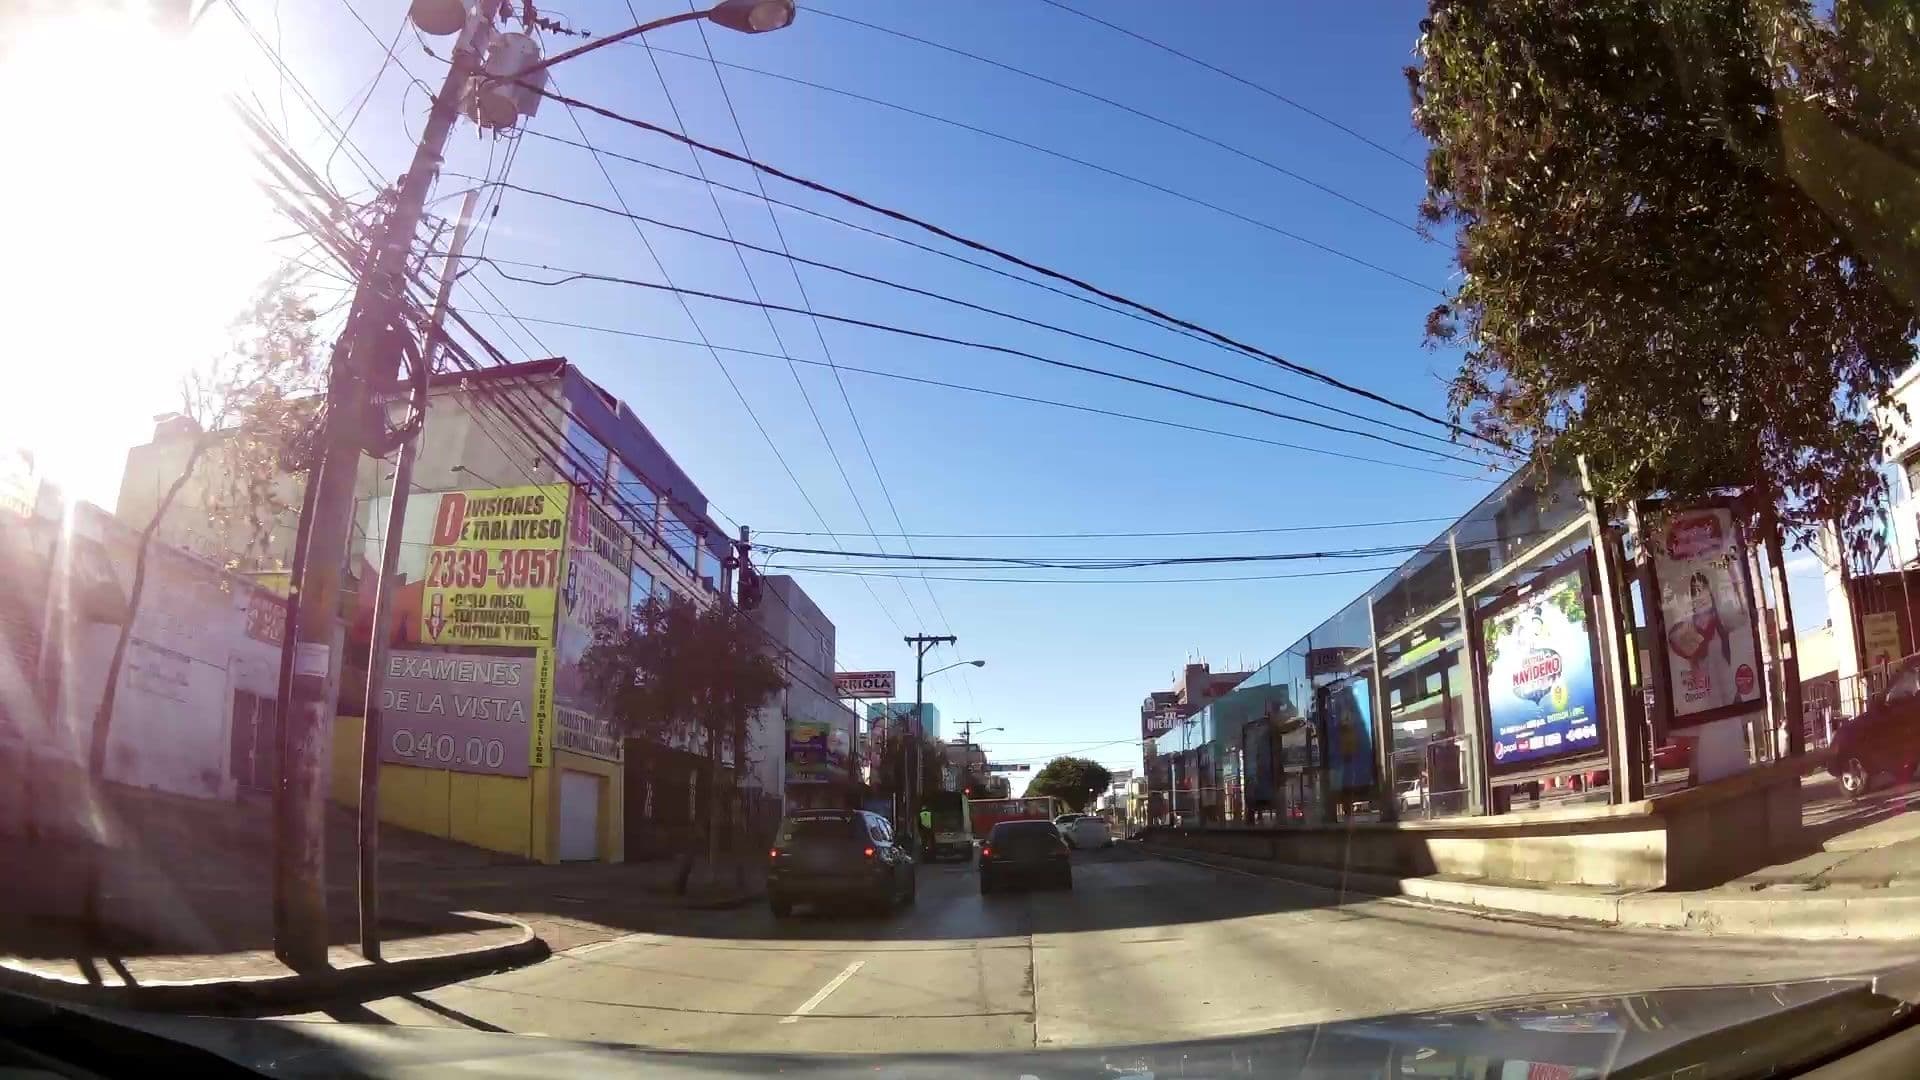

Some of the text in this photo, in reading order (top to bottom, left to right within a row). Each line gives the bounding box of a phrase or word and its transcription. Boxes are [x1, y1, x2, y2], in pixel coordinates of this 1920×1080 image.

[426, 549, 558, 589] 2339-3951
[389, 655, 521, 686] EXAMENES
[384, 688, 410, 712] DE
[415, 691, 446, 716] LA
[453, 694, 527, 723] VISTA
[392, 728, 506, 769] Q40.00
